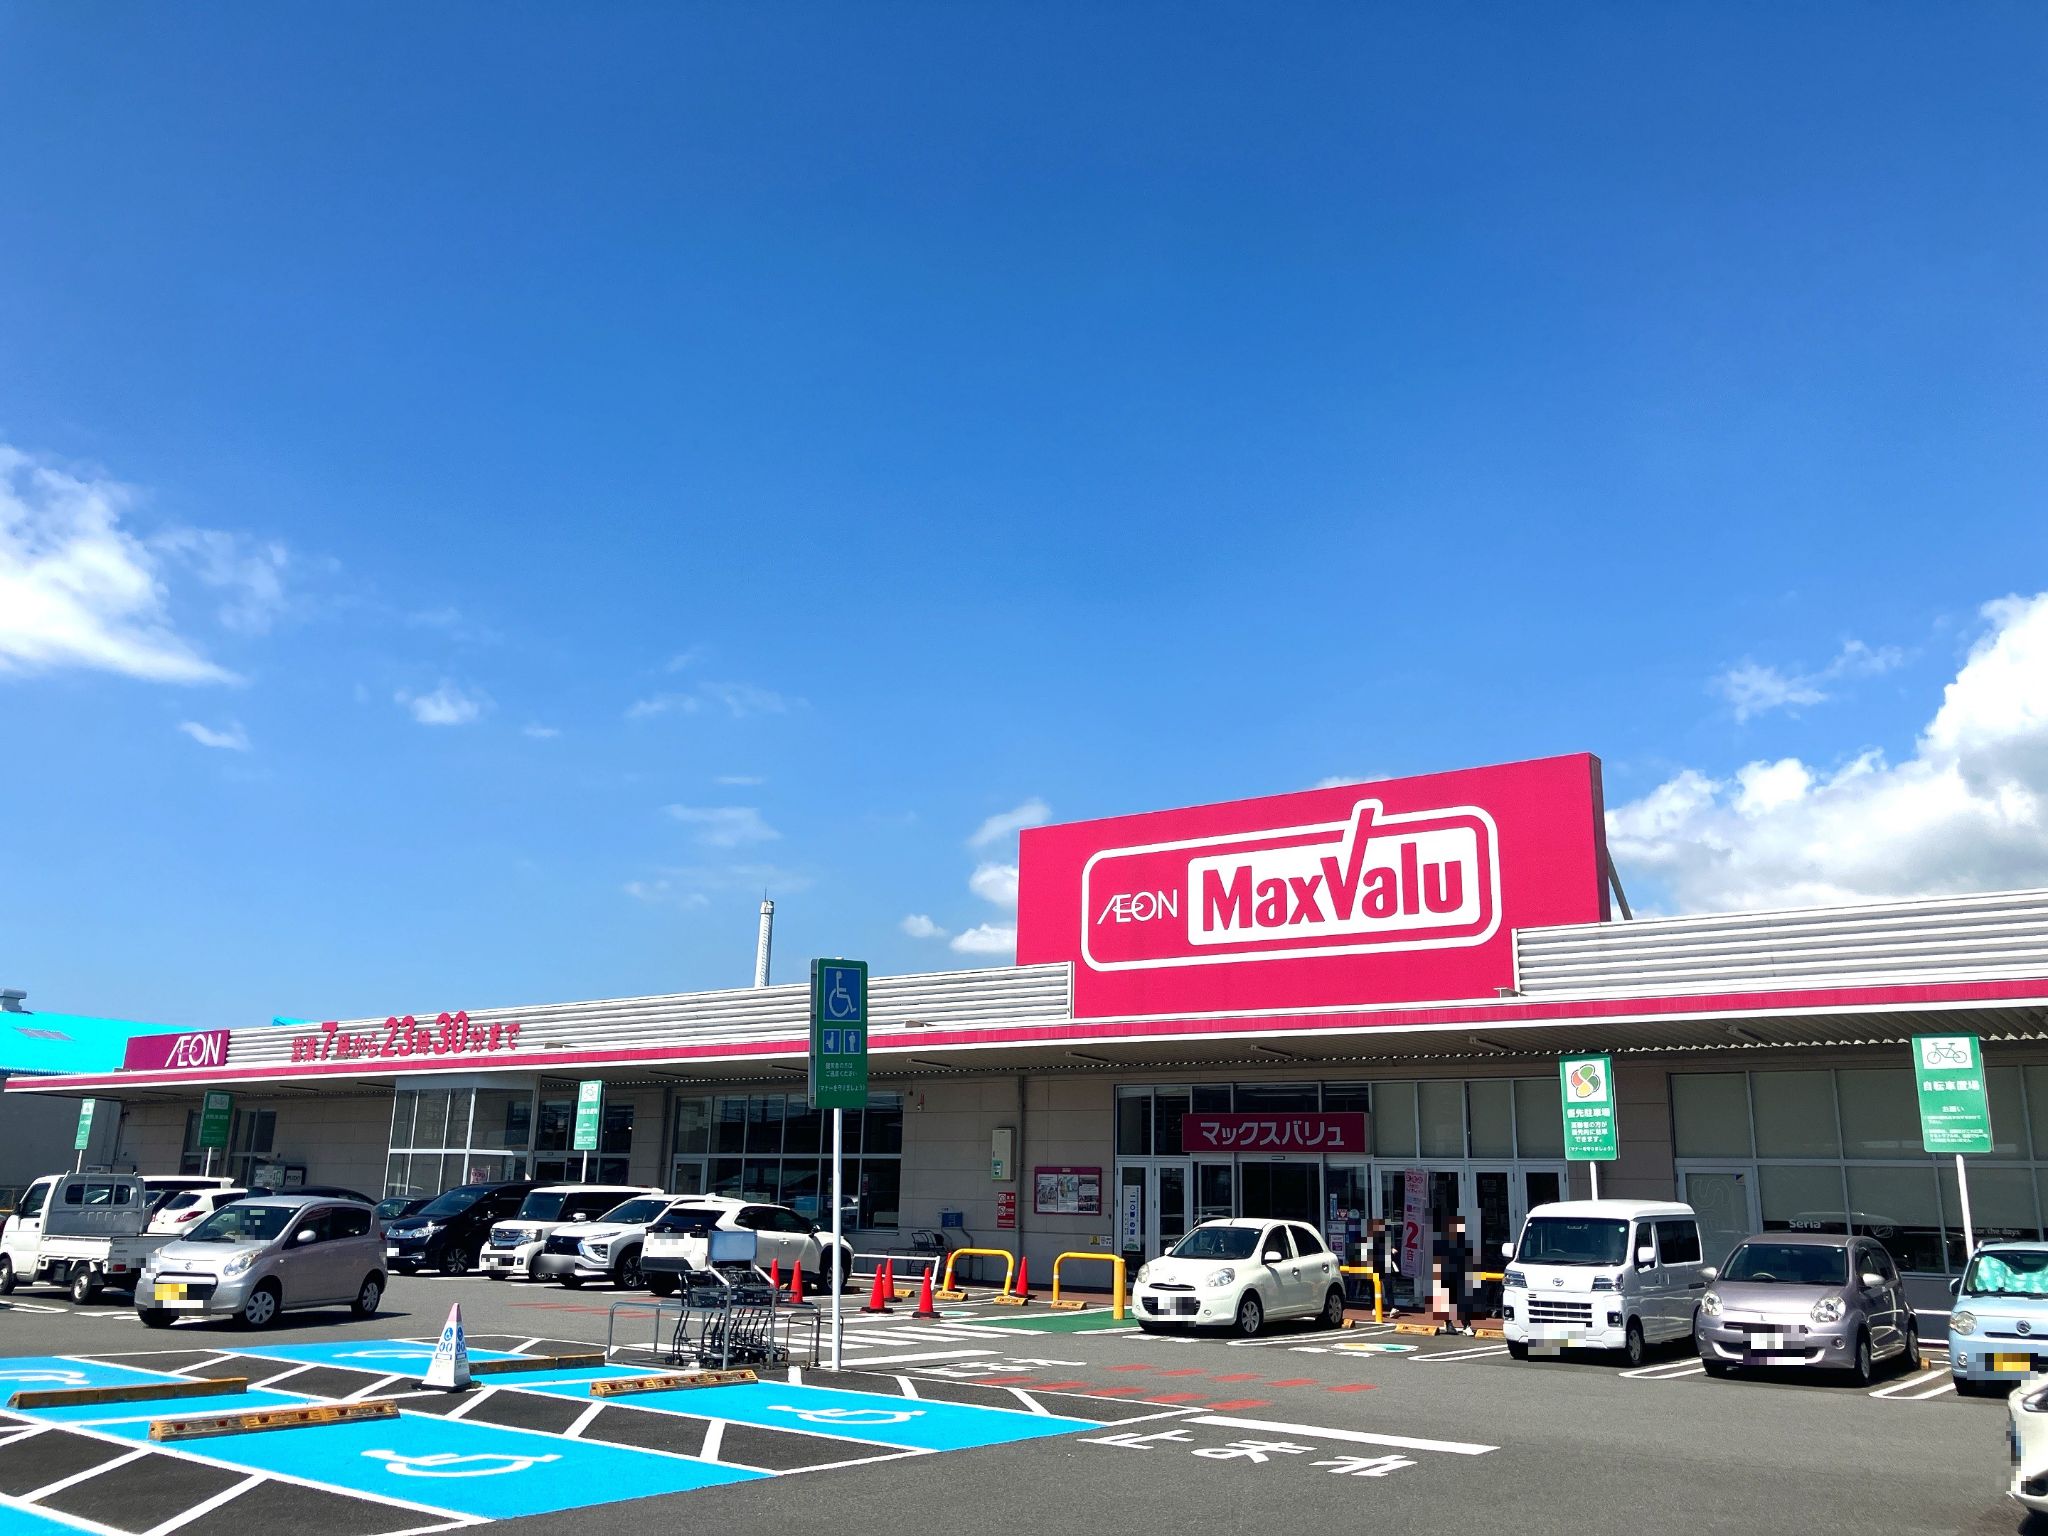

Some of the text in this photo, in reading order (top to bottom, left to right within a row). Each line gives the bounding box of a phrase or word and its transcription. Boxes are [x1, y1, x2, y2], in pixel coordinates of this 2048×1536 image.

[1202, 807, 1464, 932] MaxValu
[1923, 1080, 1980, 1091] 自転車置場
[1200, 1120, 1345, 1146] マックスバリュ
[1789, 1218, 1821, 1229] Seria
[1077, 1429, 1418, 1477] 止まれ
